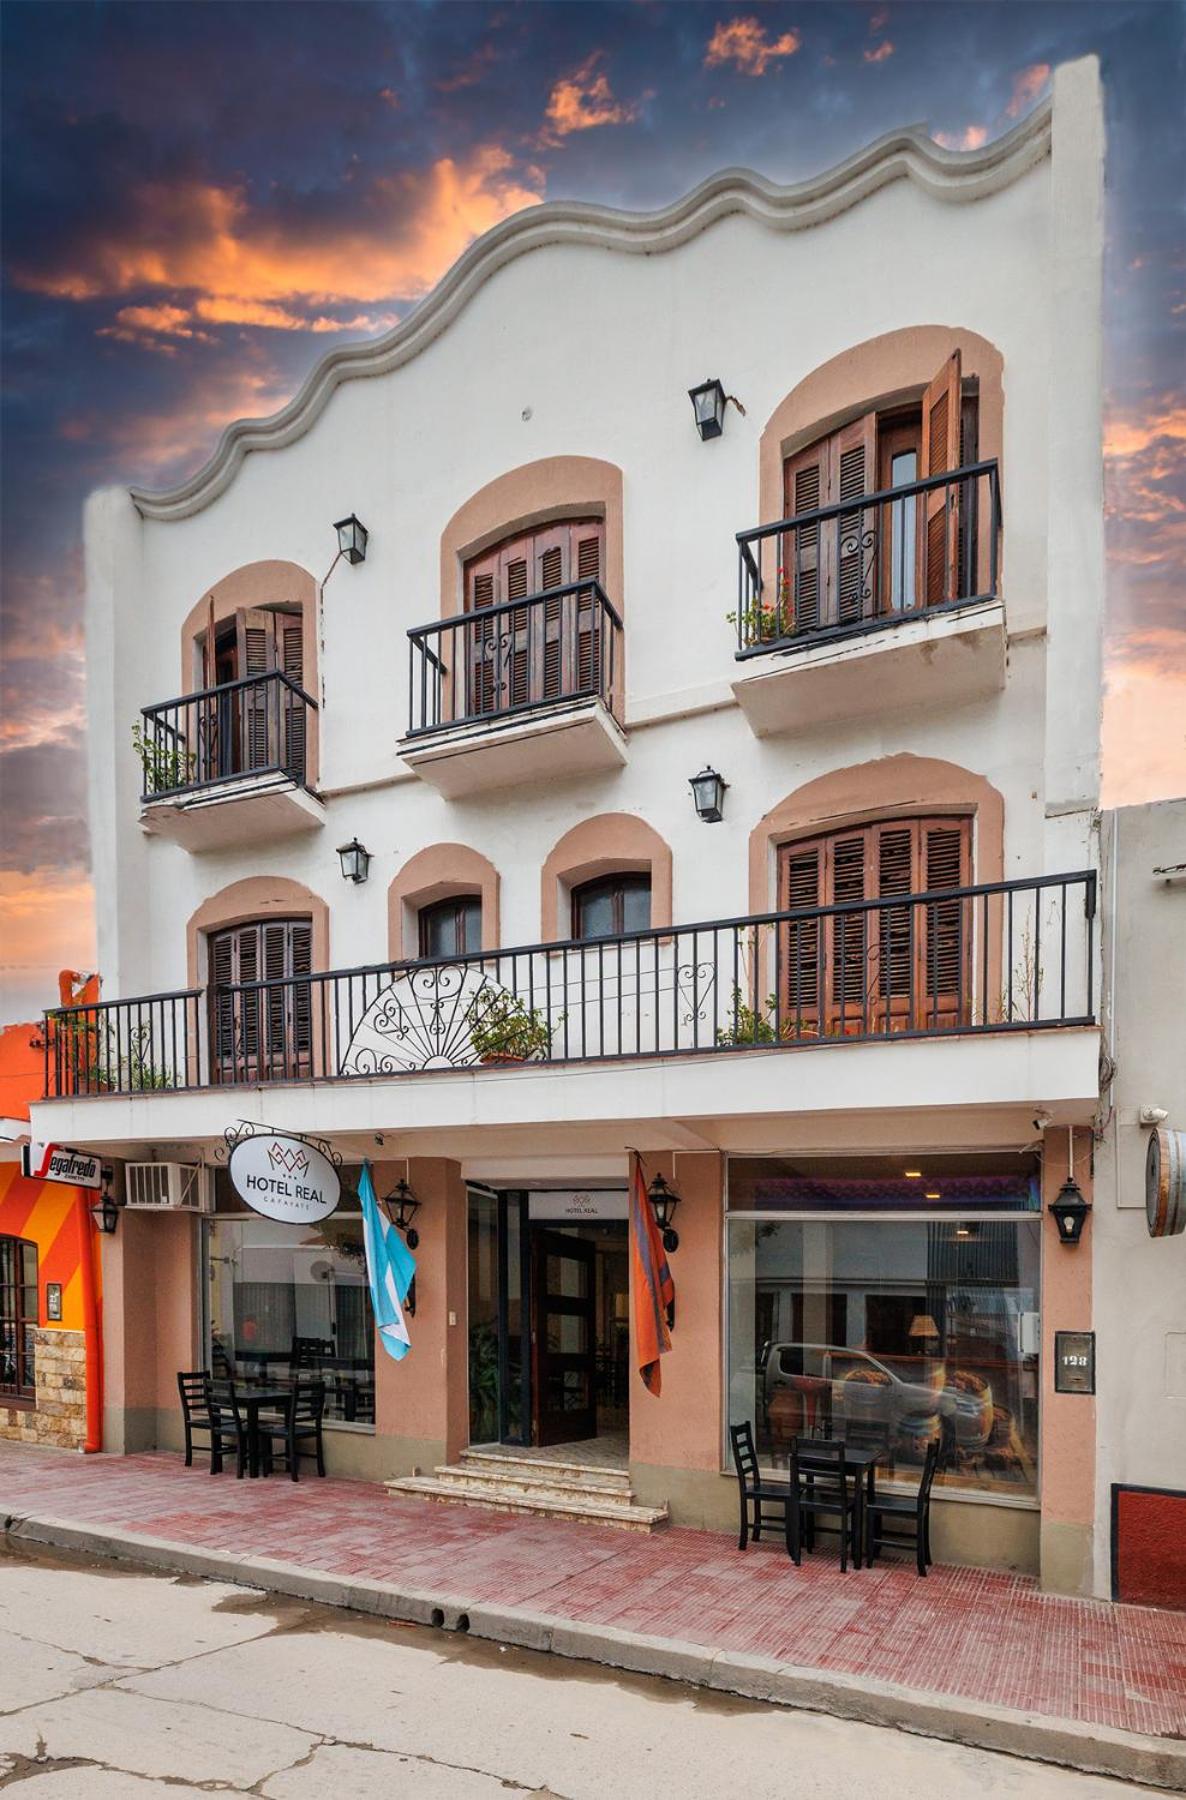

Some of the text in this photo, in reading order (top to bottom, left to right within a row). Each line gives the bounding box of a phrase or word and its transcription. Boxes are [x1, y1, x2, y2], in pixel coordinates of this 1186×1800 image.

[34, 1143, 97, 1178] Segafredo
[246, 1174, 327, 1204] HOTEL REAL
